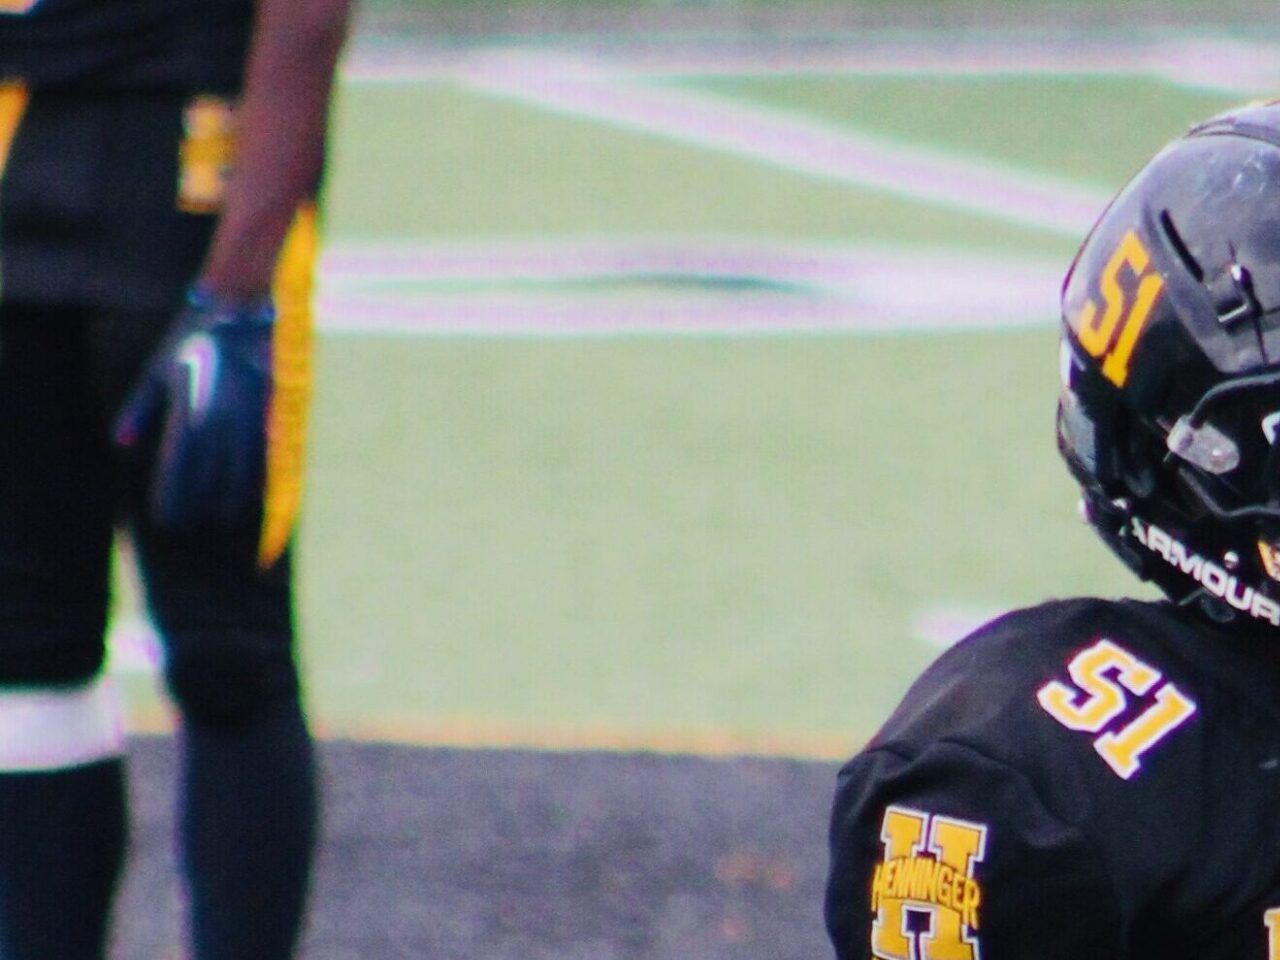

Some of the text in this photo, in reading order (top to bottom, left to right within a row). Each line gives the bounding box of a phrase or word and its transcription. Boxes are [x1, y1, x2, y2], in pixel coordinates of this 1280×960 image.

[1077, 230, 1164, 388] 51
[1037, 638, 1197, 780] 51
[871, 856, 982, 931] HENNINGER
